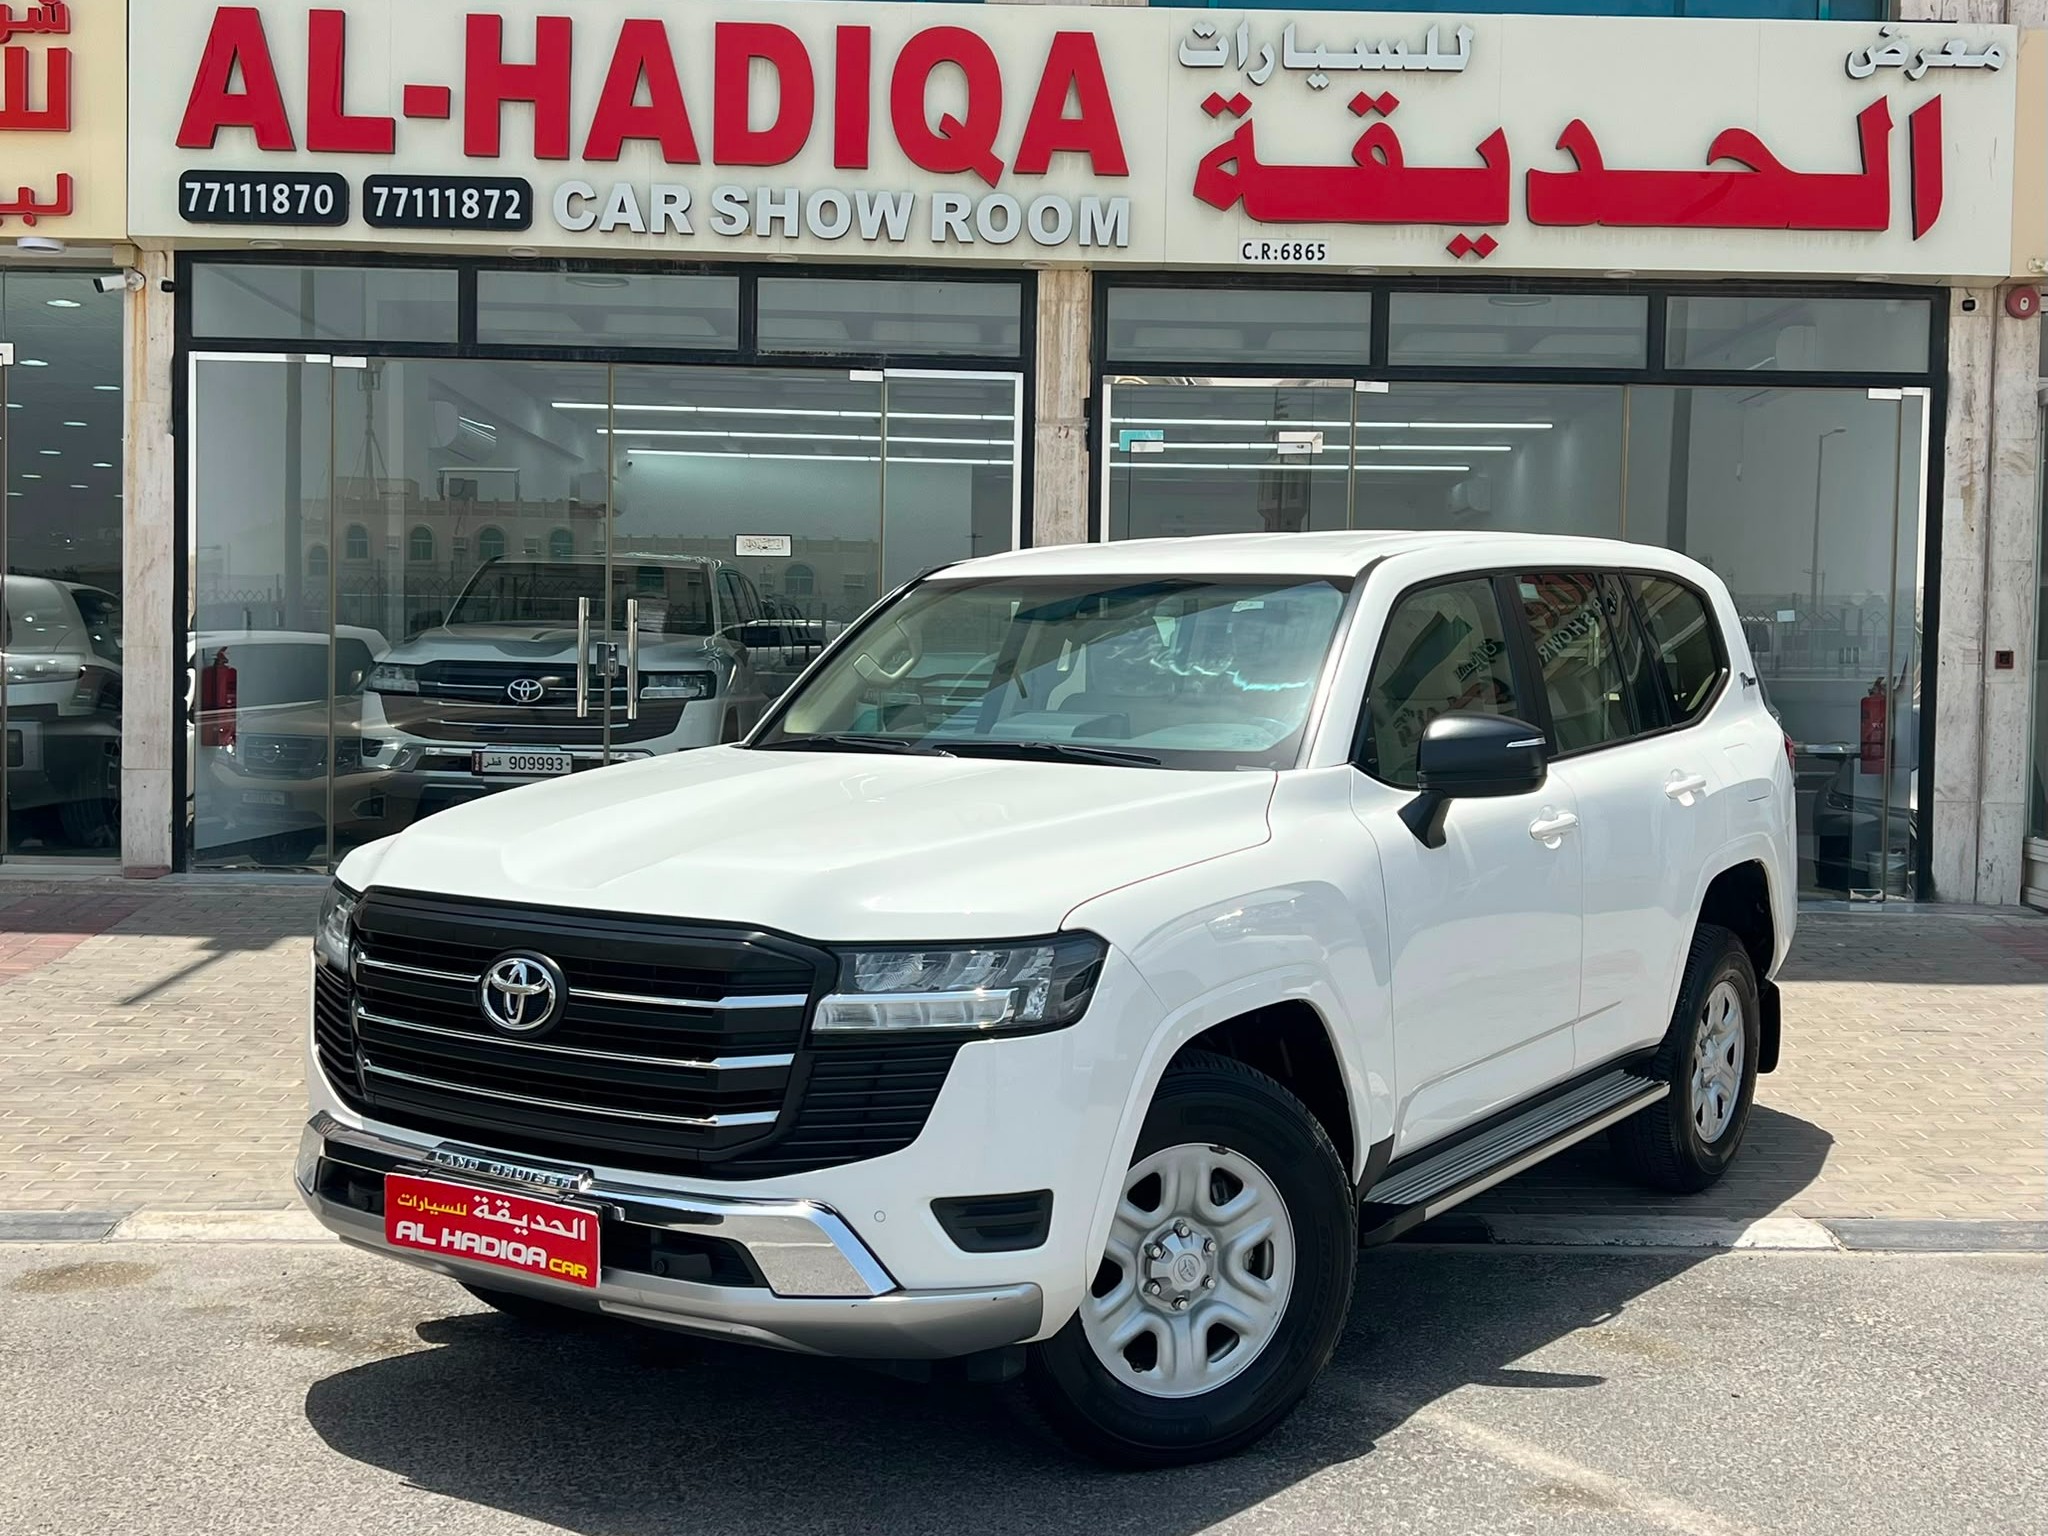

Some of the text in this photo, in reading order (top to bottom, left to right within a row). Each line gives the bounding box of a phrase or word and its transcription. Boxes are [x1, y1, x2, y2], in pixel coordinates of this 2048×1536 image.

[1178, 21, 1474, 91] للسيارات
[1845, 25, 2006, 81] معرض
[176, 6, 1129, 188] AL-HADIQA
[185, 181, 334, 216] 77111870
[1192, 92, 1943, 259] الحديقة
[371, 184, 521, 221] 77111872
[552, 180, 1130, 248] CAR SHOW ROOM
[1242, 242, 1326, 261] C.R:6865
[508, 756, 564, 771] 909993
[434, 1151, 574, 1189] LAND CRUISER
[397, 1193, 587, 1241] الحديقة للسيارات
[395, 1220, 588, 1280] AL HADIQA CAR
